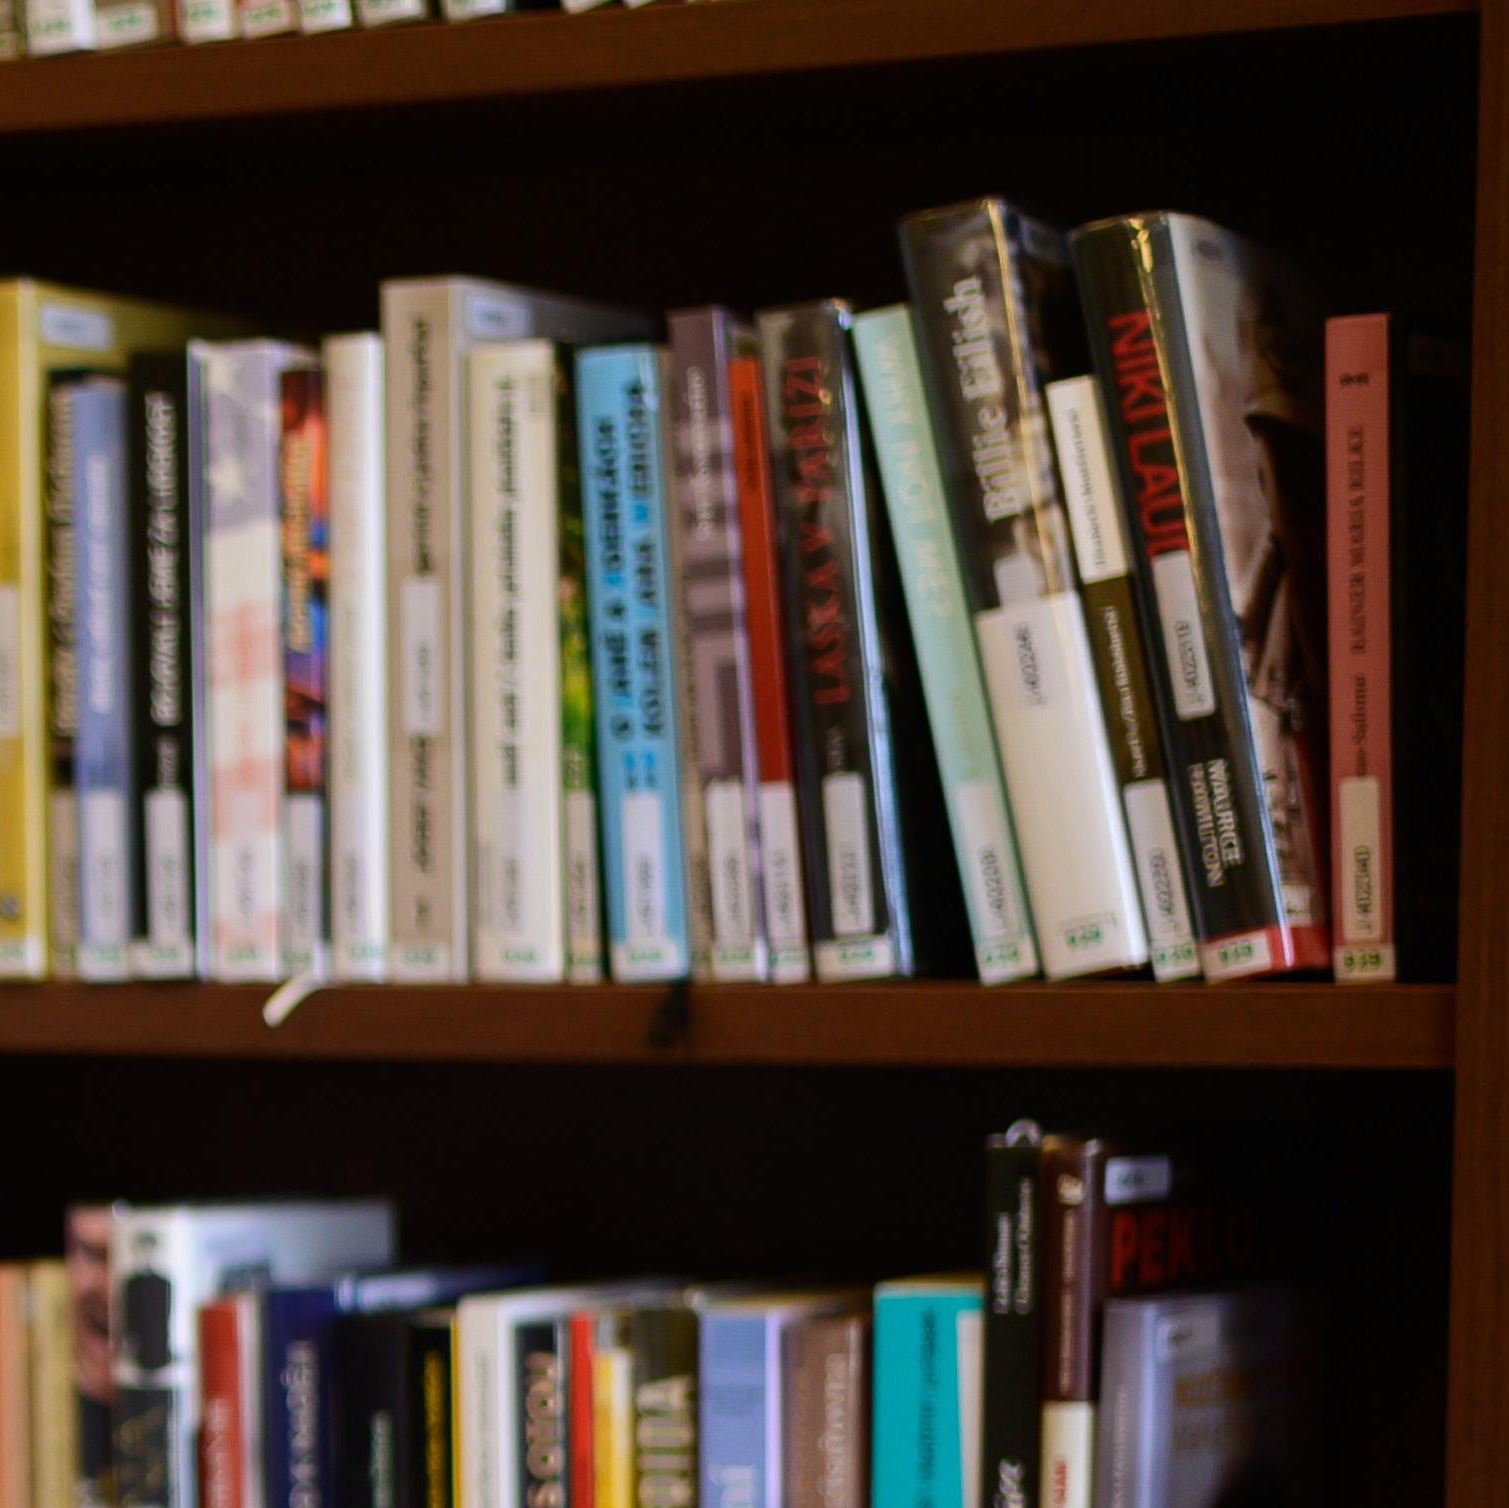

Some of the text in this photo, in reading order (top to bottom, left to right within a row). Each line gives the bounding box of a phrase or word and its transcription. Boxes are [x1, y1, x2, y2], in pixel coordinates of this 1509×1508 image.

[878, 330, 912, 412] WHY
[944, 275, 1029, 525] Billie Eilish
[1107, 310, 1169, 426] NIKI
[892, 424, 935, 529] NOT
[1350, 425, 1368, 492] RILKE
[1350, 497, 1368, 578] MARIA
[1189, 762, 1224, 888] HAMILTON
[1205, 757, 1247, 868] MAURICE
